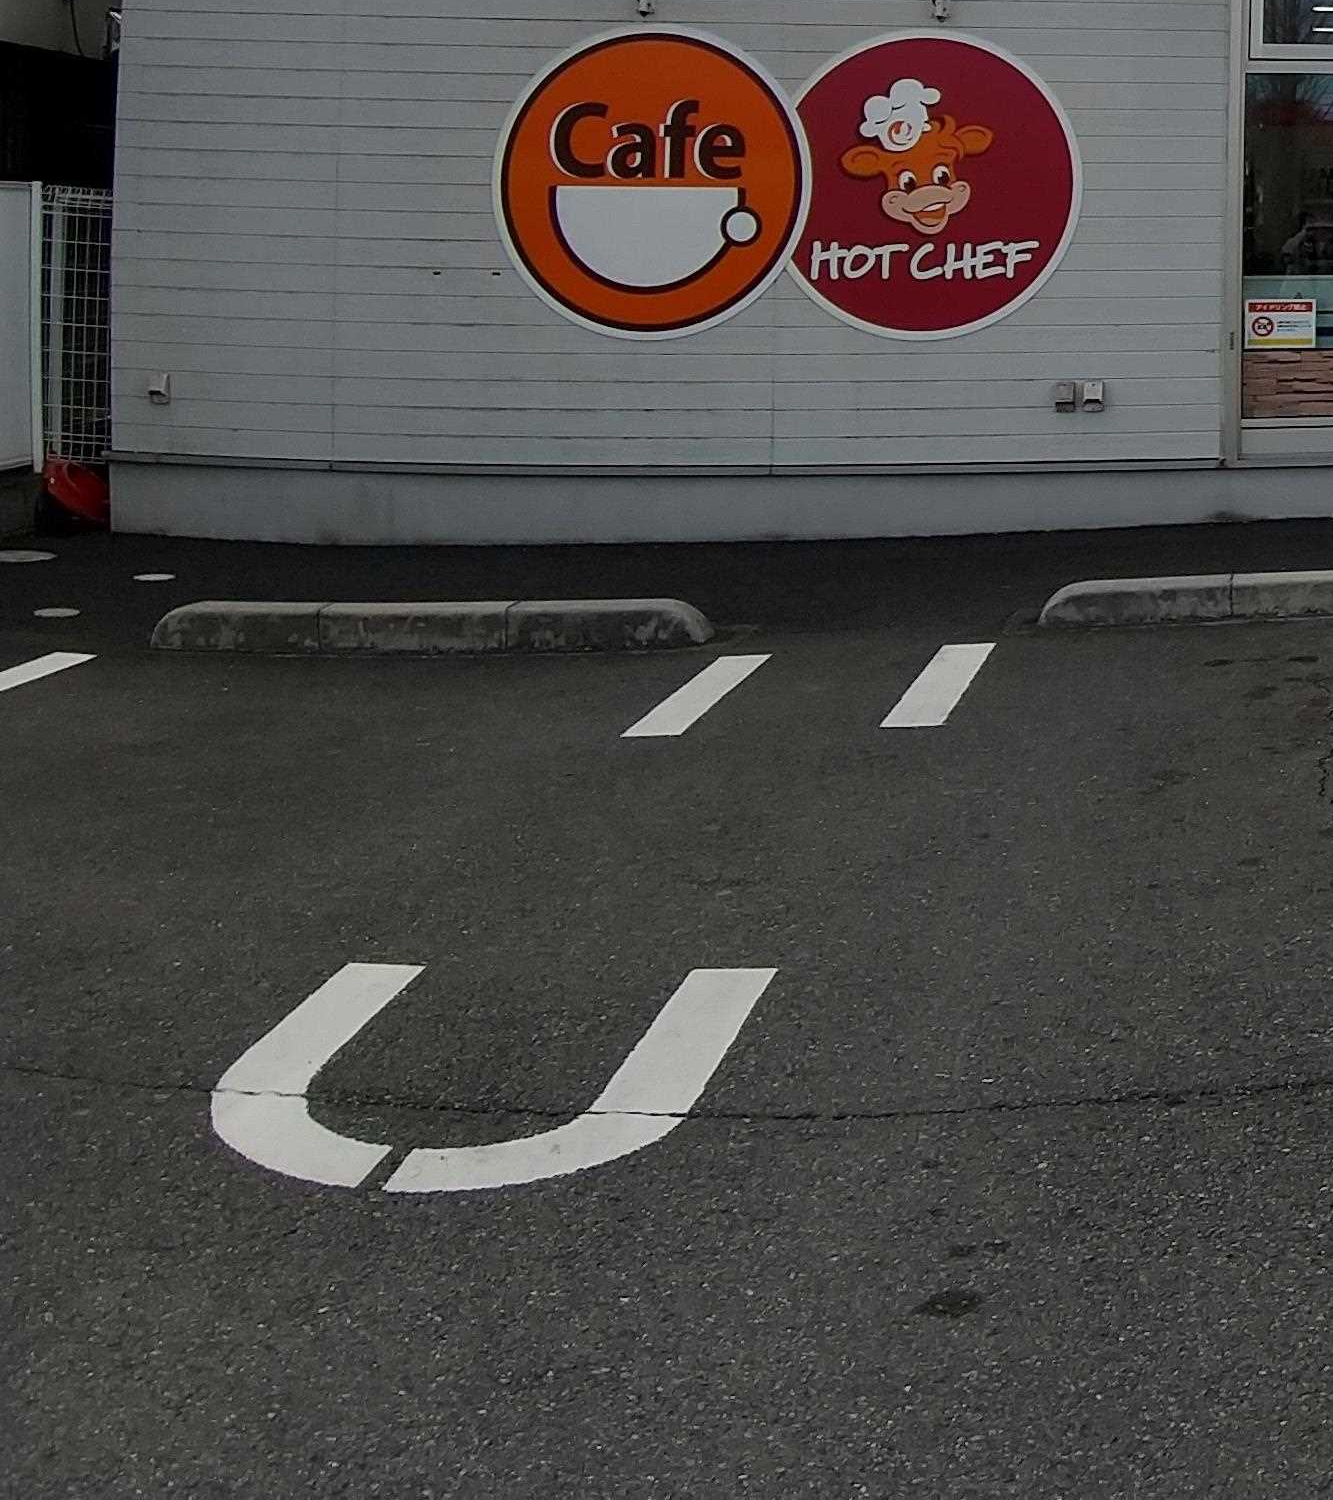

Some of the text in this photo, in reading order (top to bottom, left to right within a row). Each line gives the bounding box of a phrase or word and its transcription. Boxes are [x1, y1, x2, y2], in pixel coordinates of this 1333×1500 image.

[549, 100, 746, 181] Cafe
[810, 240, 1040, 280] HOT CHEF
